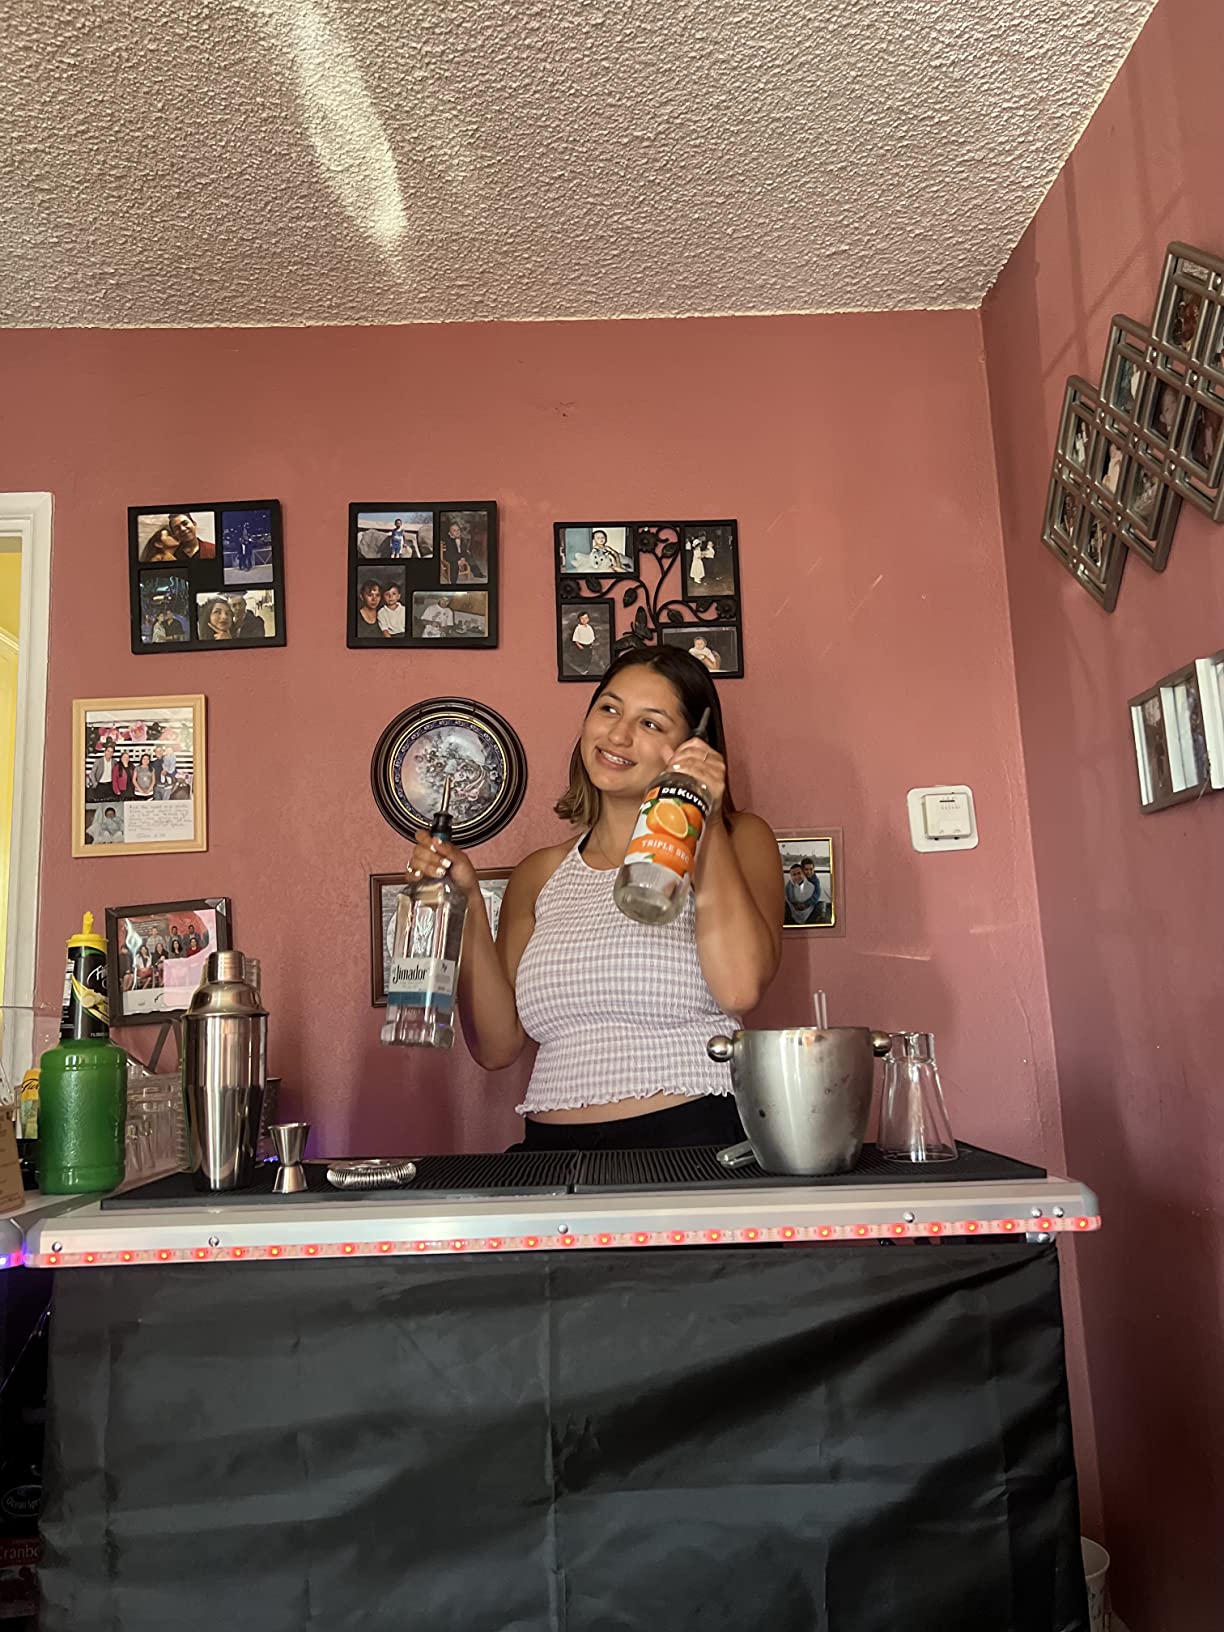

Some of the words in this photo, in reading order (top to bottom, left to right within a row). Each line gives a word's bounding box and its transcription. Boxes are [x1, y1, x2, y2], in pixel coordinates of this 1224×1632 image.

[641, 838, 675, 853] TRIPLE
[392, 963, 428, 985] Jimador
[0, 1544, 38, 1561] ranb
